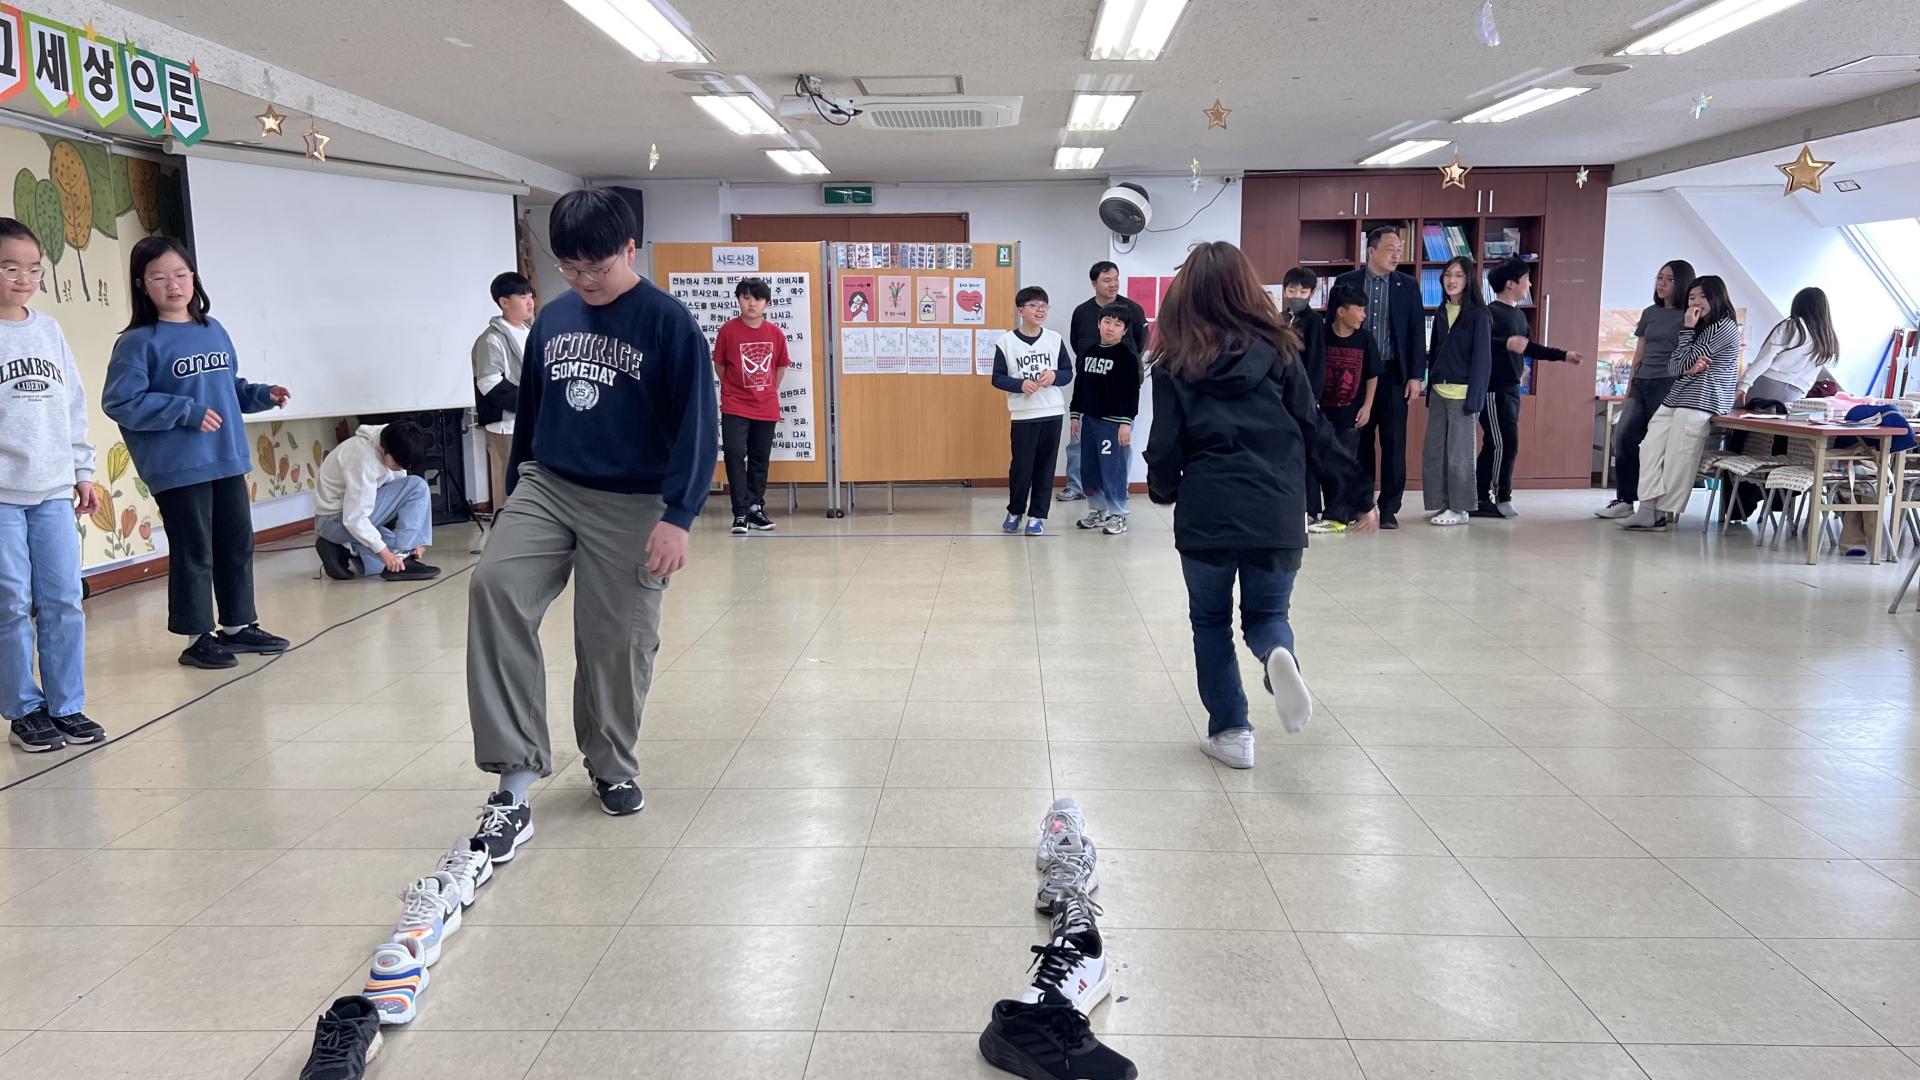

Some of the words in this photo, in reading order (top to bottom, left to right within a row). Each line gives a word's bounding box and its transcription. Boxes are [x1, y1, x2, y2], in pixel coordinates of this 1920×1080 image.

[36, 30, 199, 124] 세상으로
[716, 254, 754, 266] 사도신경
[777, 276, 805, 285] 아버지를
[775, 287, 782, 295] 주
[790, 287, 805, 295] 예수
[1016, 353, 1051, 372] NORTH
[551, 361, 617, 387] SOMEDAY
[1023, 371, 1042, 383] FAC
[17, 381, 48, 391] LIBERTY
[792, 430, 806, 438] 다시
[1101, 439, 1112, 455] 2
